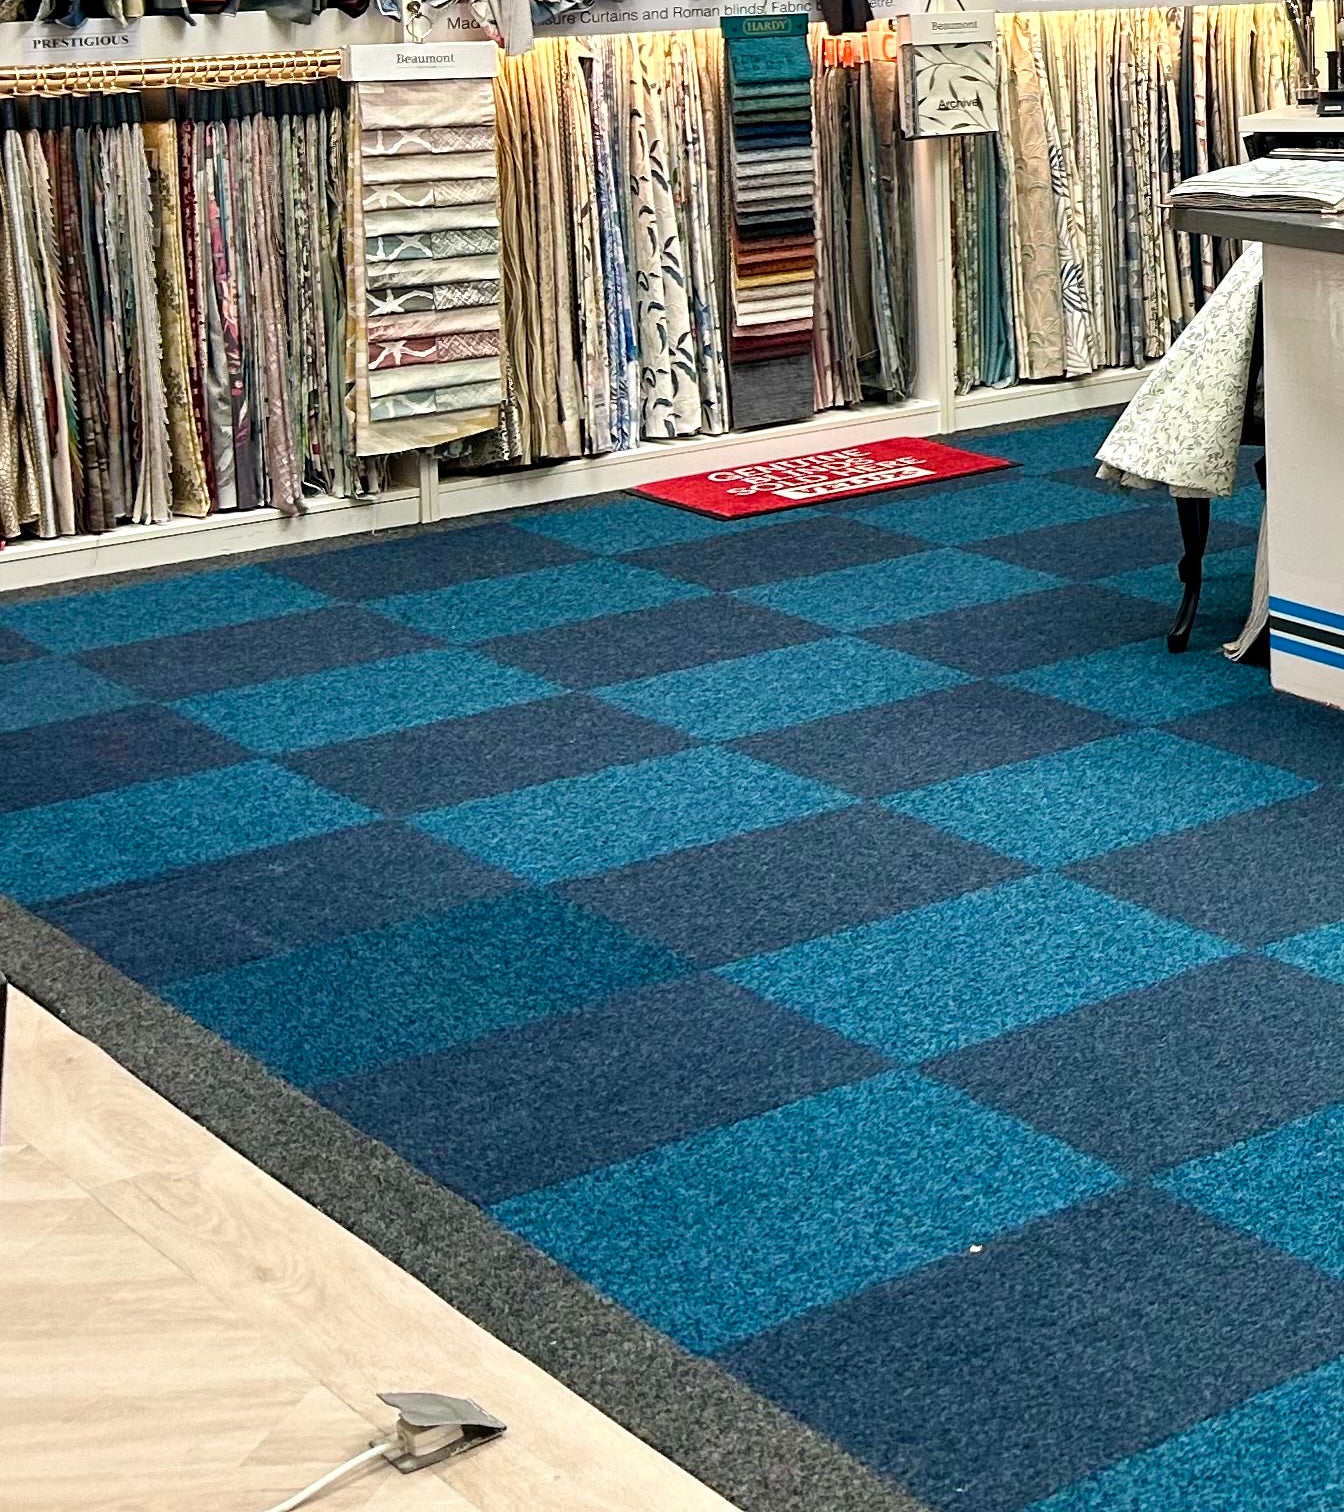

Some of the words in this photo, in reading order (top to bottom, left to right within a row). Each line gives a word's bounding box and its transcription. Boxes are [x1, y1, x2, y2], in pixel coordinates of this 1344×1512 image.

[446, 16, 481, 30] Mad
[579, 10, 638, 25] Curtains
[641, 6, 669, 21] and
[672, 4, 720, 19] Roman
[771, 0, 813, 15] Fabric
[746, 20, 787, 32] HARDY
[32, 34, 129, 50] PRESTIGIOUS
[396, 53, 456, 64] Beaumont
[707, 447, 873, 483] GENUINE
[726, 471, 829, 497] SOLD
[829, 455, 928, 479] HERE
